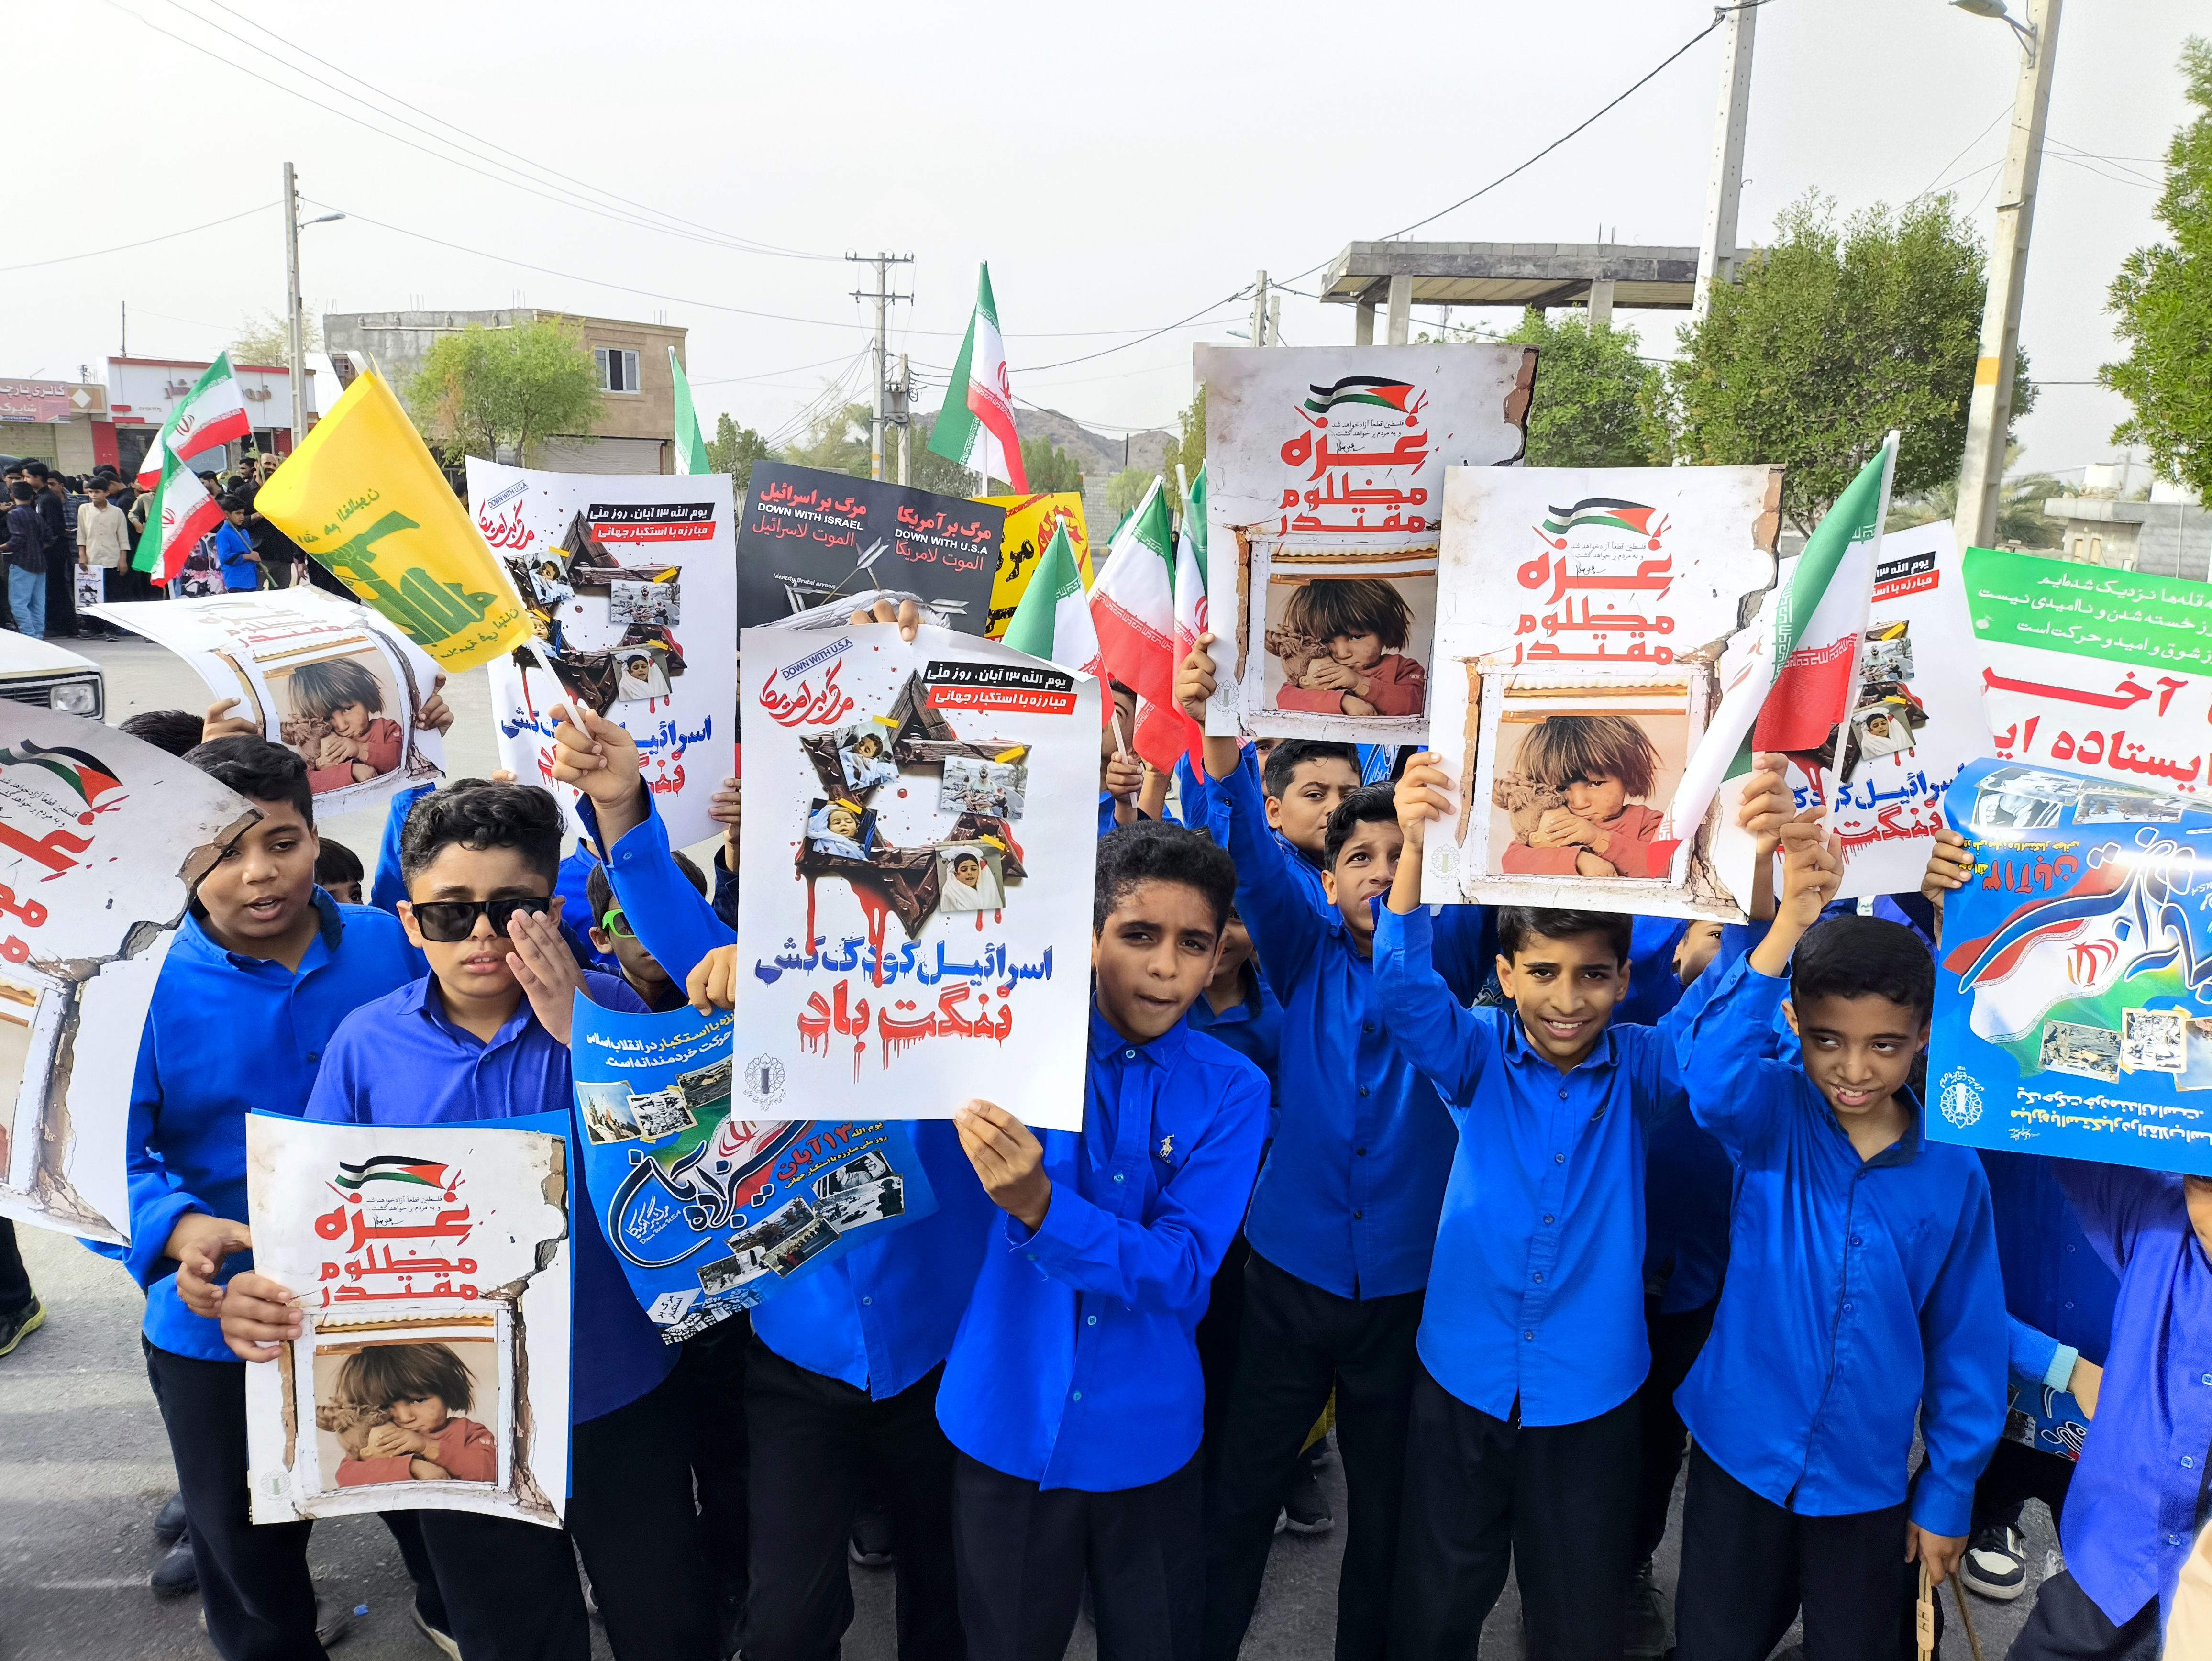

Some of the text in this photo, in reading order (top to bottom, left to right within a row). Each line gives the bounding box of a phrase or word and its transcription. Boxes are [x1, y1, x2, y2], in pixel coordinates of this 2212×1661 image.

[32, 384, 65, 398] گالری
[1384, 421, 1404, 429] فلسطین
[488, 495, 503, 508] DOWN
[502, 489, 515, 499] WITH
[1279, 472, 1428, 509] مظلوم
[760, 482, 867, 518] مرگ بر اسرائیل
[611, 509, 628, 519] روز
[656, 509, 669, 518] ۱۳
[690, 507, 708, 520] یوم
[757, 503, 863, 531] DOWN WITH ISRAEL
[1277, 504, 1426, 537] مقتدر
[752, 515, 855, 547] الموت لاسرائیل
[897, 505, 992, 543] مرگ بر آمریکا
[598, 526, 708, 539] مبارزه با استکبار جهانی
[895, 529, 988, 555] DOWN WITH U.S.A
[896, 540, 984, 572] الموت لامریکا
[1911, 560, 1929, 574] یوم
[796, 577, 815, 586] Brutal
[816, 581, 836, 589] arrows
[1891, 584, 1899, 594] با
[1901, 577, 1932, 590] مبارزه
[1978, 587, 2030, 605] نیست
[2096, 580, 2157, 603] نزدیک
[1513, 595, 1674, 636] مظلوم
[2093, 608, 2106, 619] و
[2106, 609, 2143, 623] شدن
[2144, 614, 2195, 629] خسته
[2016, 621, 2201, 660] شوق و امید و حرکت است
[1511, 631, 1674, 668] مقتدر
[782, 639, 852, 679] DOWN WITH U.S.A
[952, 667, 972, 681] روز
[1006, 671, 1020, 681] ۱۳
[1045, 678, 1066, 689] یوم
[935, 690, 1067, 709] مبارزه با استکبار جهانی
[12, 796, 32, 807] خواهد
[35, 810, 52, 819] مردم
[53, 805, 79, 818] فلسطین
[2052, 841, 2079, 852] جهانی
[1983, 860, 2014, 892] ۱۳
[2014, 854, 2079, 894] آبان
[917, 940, 1053, 990] اسرائیل
[709, 1022, 719, 1031] با
[611, 1039, 644, 1053] انقلاب
[658, 1025, 710, 1052] استکبار
[698, 1030, 732, 1052] حرکت
[644, 1041, 657, 1053] در
[2016, 1086, 2041, 1105] یک
[2042, 1091, 2082, 1107] حرکت
[868, 1121, 884, 1133] یوم
[2010, 1107, 2050, 1124] مبارزه
[2051, 1110, 2061, 1127] با
[2061, 1115, 2123, 1133] استکبار
[2122, 1118, 2140, 1132] در
[2138, 1124, 2185, 1141] انقلاب
[823, 1121, 853, 1149] ۱۳
[874, 1135, 887, 1144] روز
[777, 1134, 821, 1181] آبان
[837, 1146, 859, 1158] مبارزه
[807, 1158, 831, 1176] استکبار
[785, 1173, 806, 1189] جهانی
[421, 1196, 442, 1204] فلسطین
[317, 1243, 478, 1281] مظلوم
[317, 1272, 478, 1309] مقتدر
